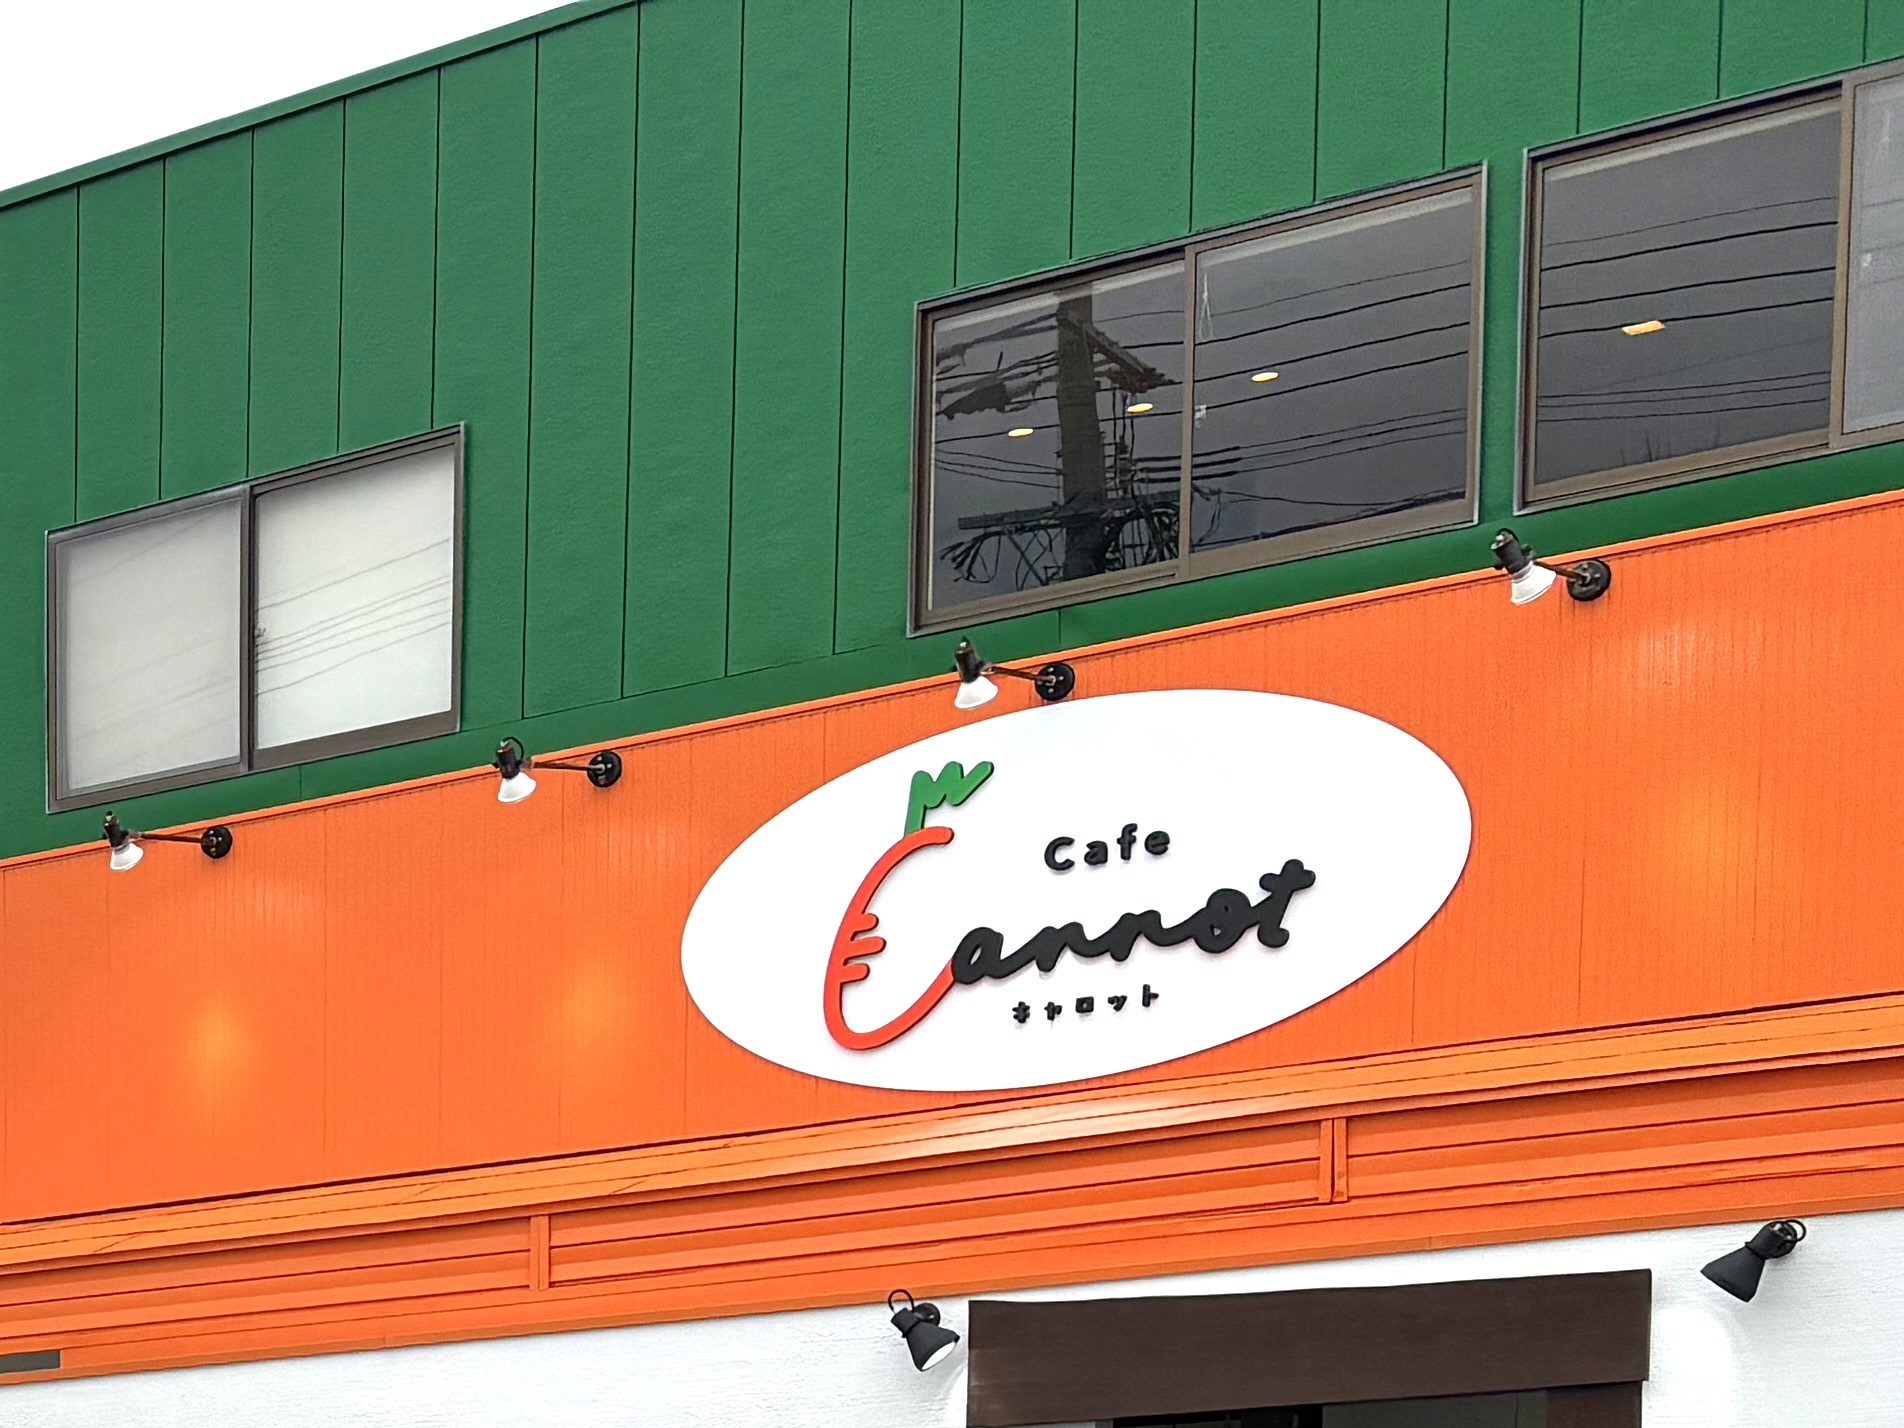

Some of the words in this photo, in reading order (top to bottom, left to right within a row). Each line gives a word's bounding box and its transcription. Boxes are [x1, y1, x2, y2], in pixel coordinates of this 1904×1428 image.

[1044, 822, 1170, 872] Cafe
[1012, 984, 1159, 1024] キャロット
